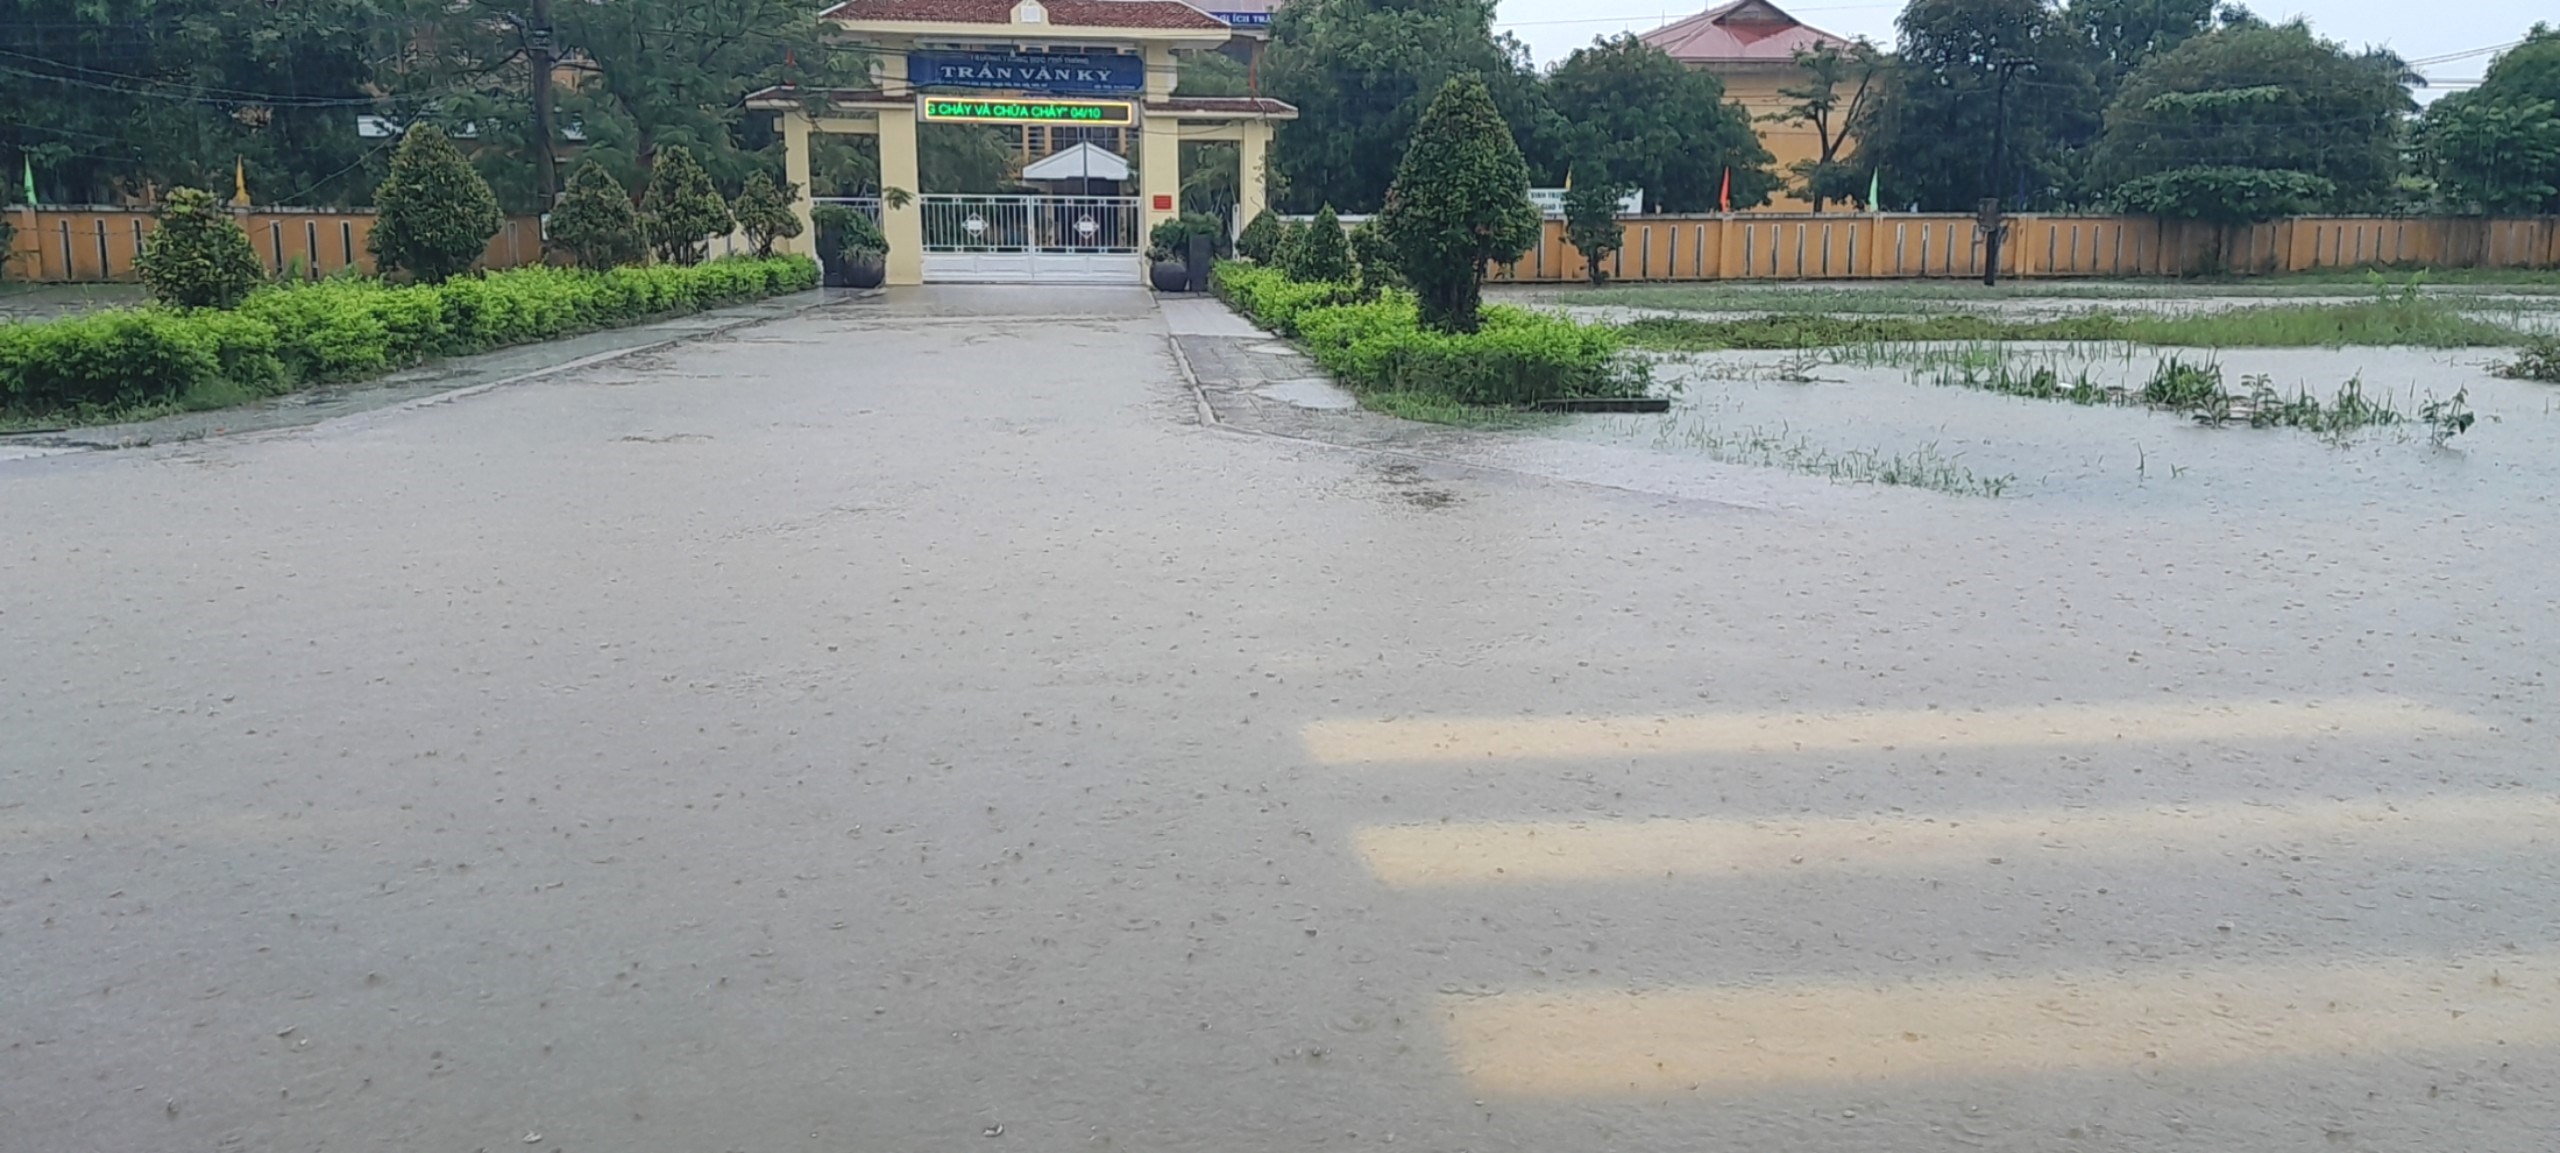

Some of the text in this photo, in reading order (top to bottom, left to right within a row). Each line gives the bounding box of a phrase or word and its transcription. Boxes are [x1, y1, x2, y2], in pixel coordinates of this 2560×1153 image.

[1019, 65, 1071, 81] VĂN
[974, 102, 992, 117] VÀ
[1070, 106, 1102, 119] 04/10
